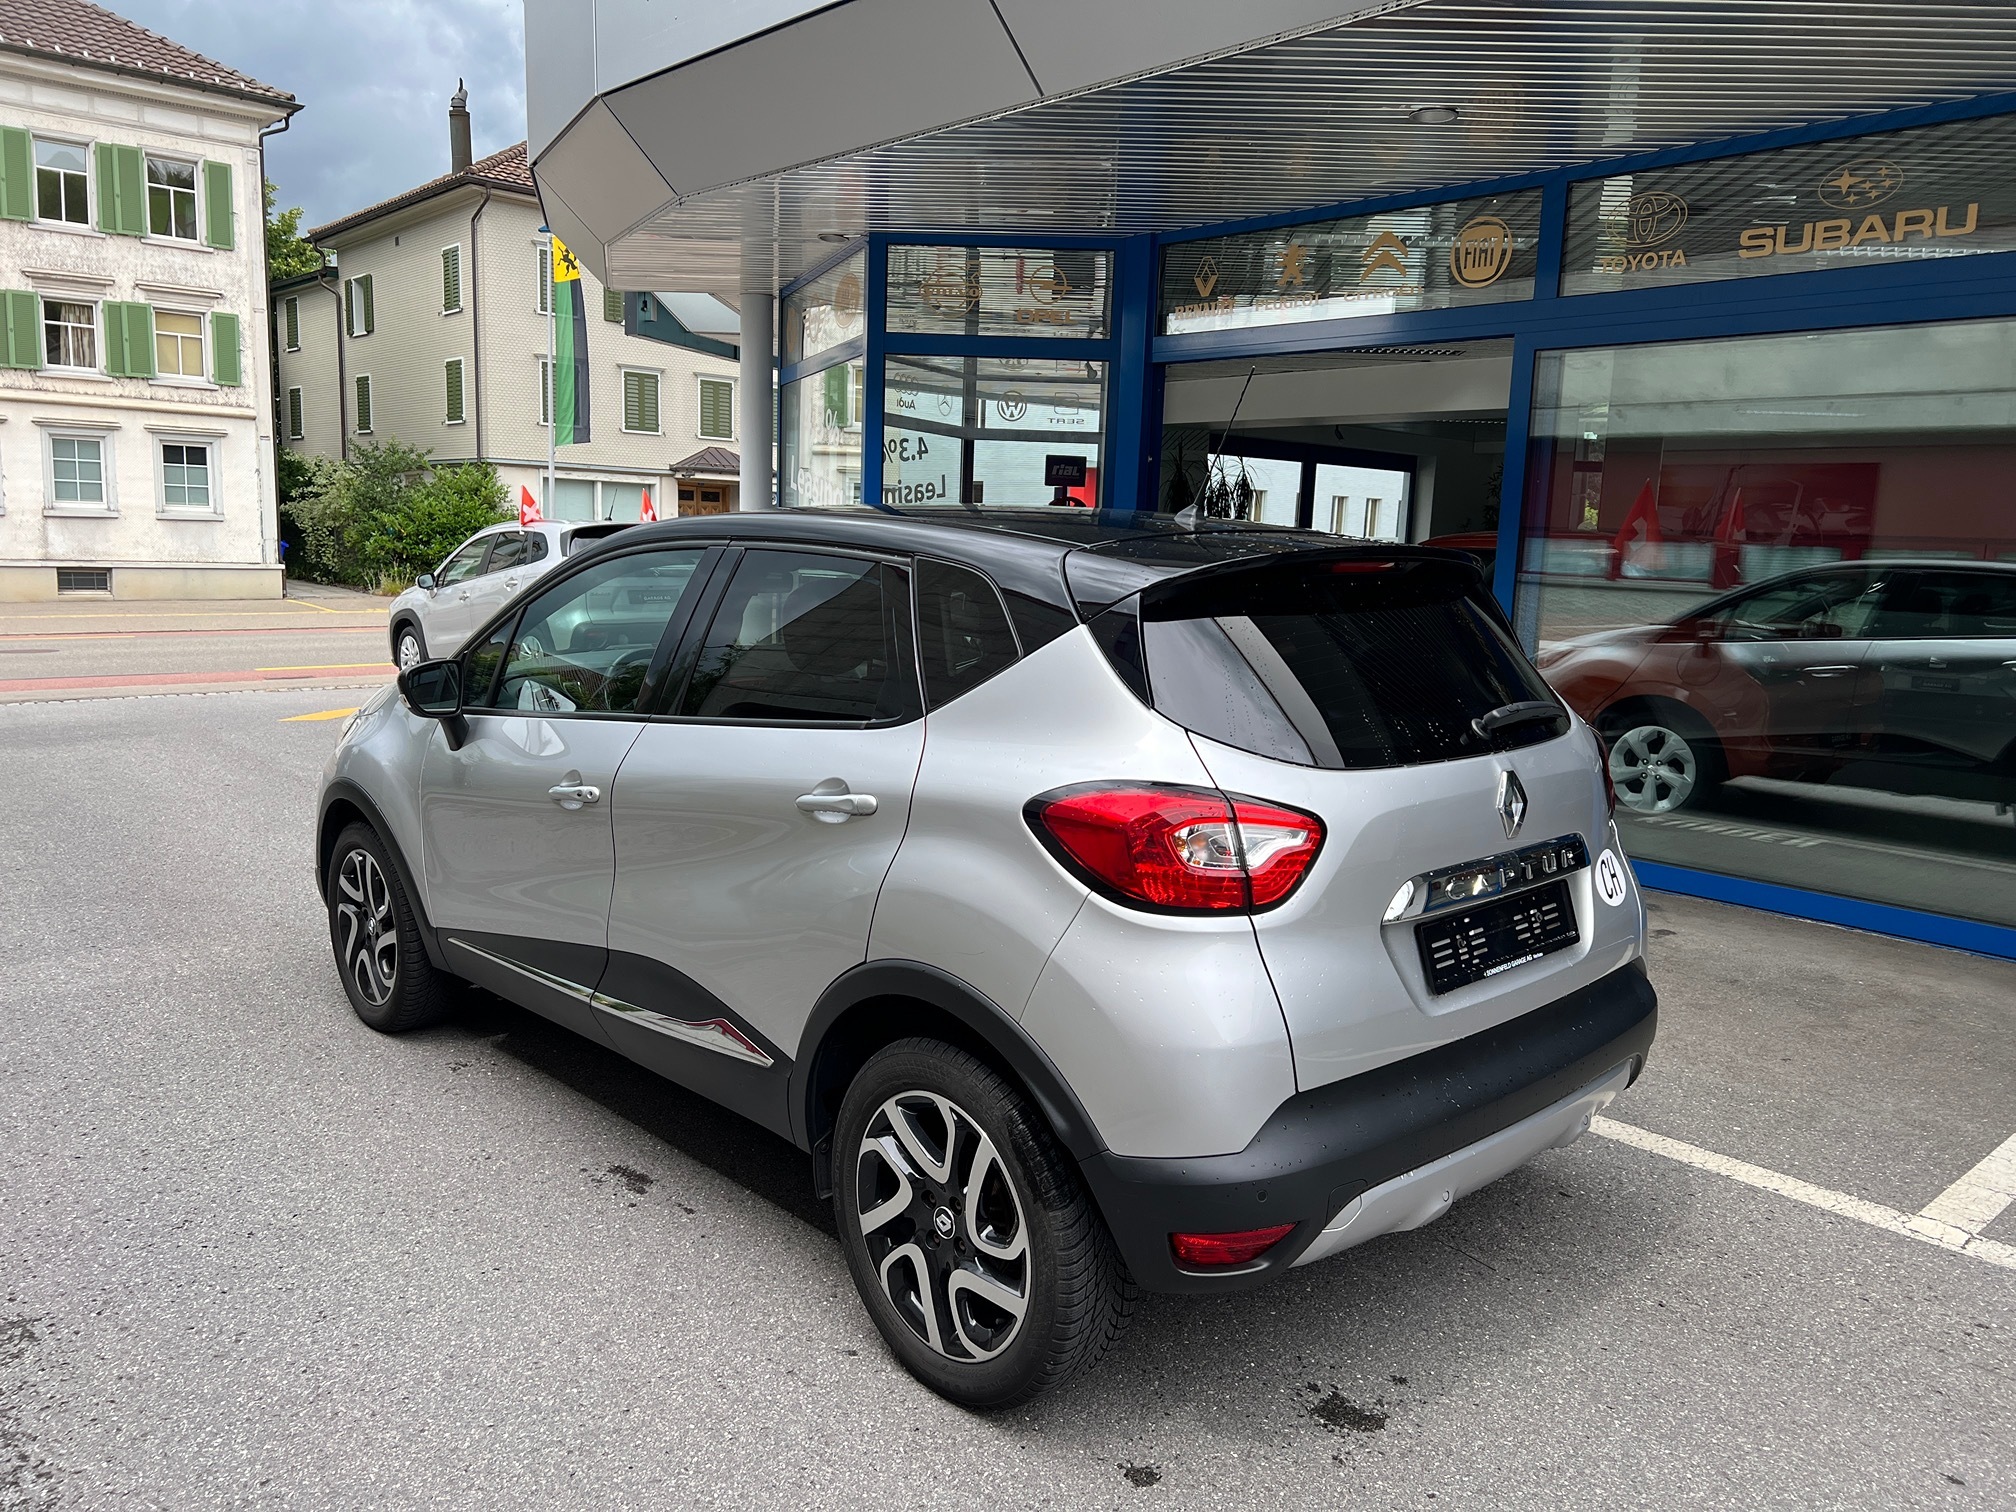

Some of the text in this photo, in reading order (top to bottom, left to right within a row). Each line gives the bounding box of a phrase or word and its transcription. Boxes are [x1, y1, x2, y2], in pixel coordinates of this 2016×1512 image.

[1738, 203, 1979, 259] SUBARU
[1463, 236, 1499, 270] FIAT
[1600, 249, 1687, 273] TOYOTA
[1174, 299, 1235, 320] RENAULT
[1255, 292, 1322, 311] PEUGEOT
[1016, 308, 1078, 325] OPEL
[1445, 849, 1576, 900] CAPTUR
[1600, 855, 1623, 900] CH
